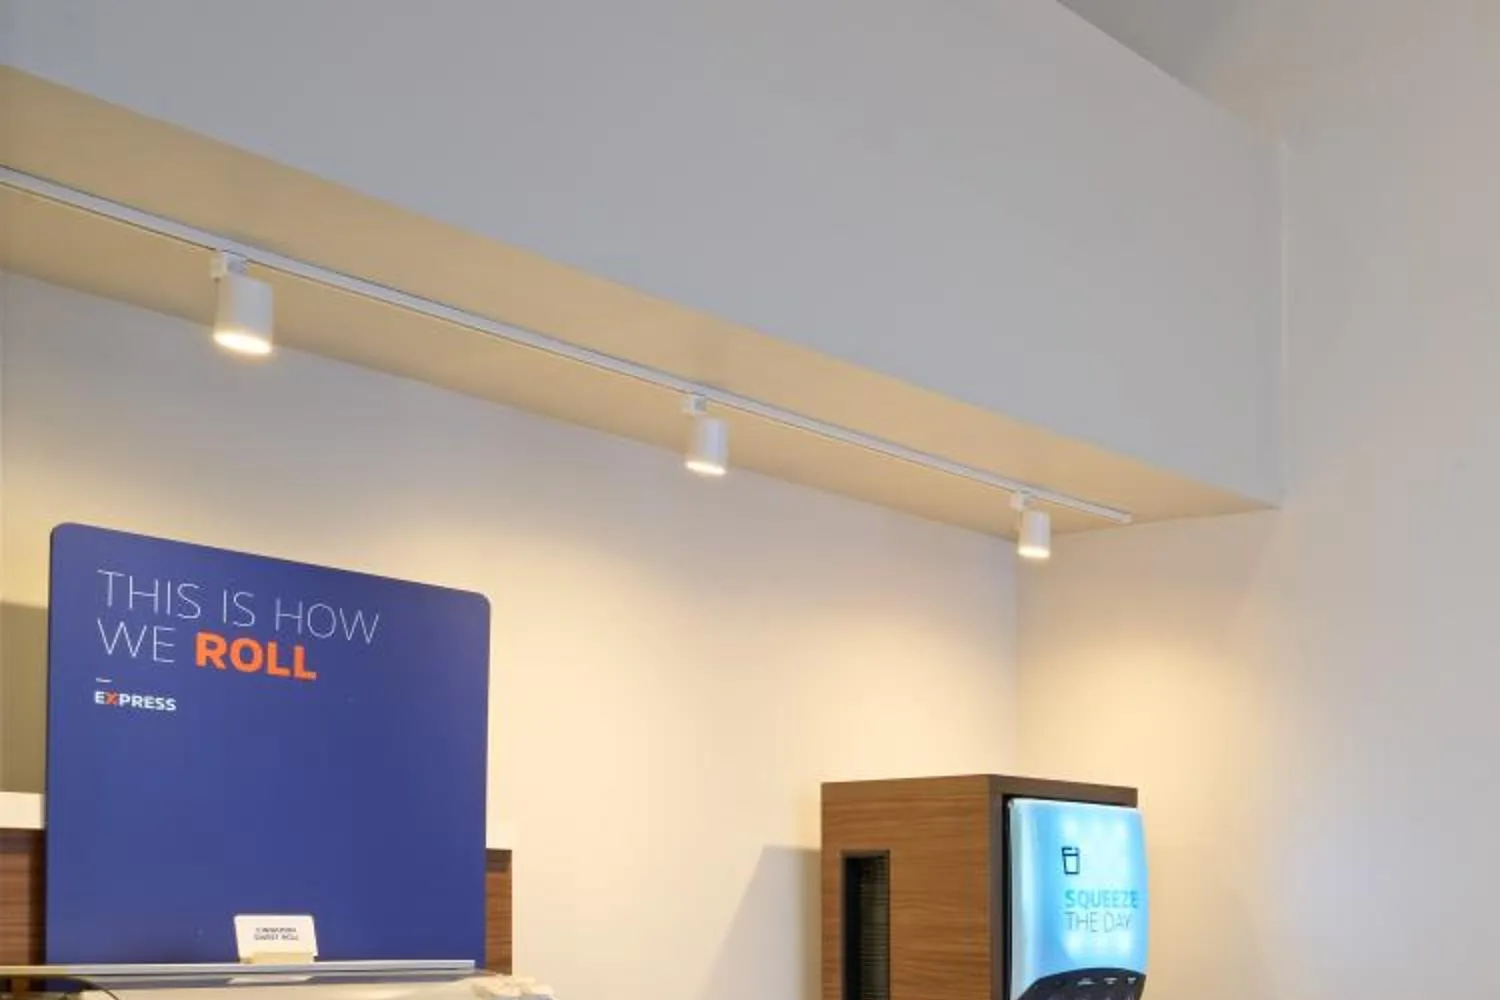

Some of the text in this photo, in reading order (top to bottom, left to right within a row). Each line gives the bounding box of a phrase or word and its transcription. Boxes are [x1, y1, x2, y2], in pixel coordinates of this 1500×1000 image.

[97, 569, 380, 645] THIS IS HOW
[97, 617, 317, 681] WE ROLL
[95, 690, 177, 711] EXPRESS
[1064, 889, 1139, 909] SQUEEZE
[1064, 910, 1133, 933] THE DAY
